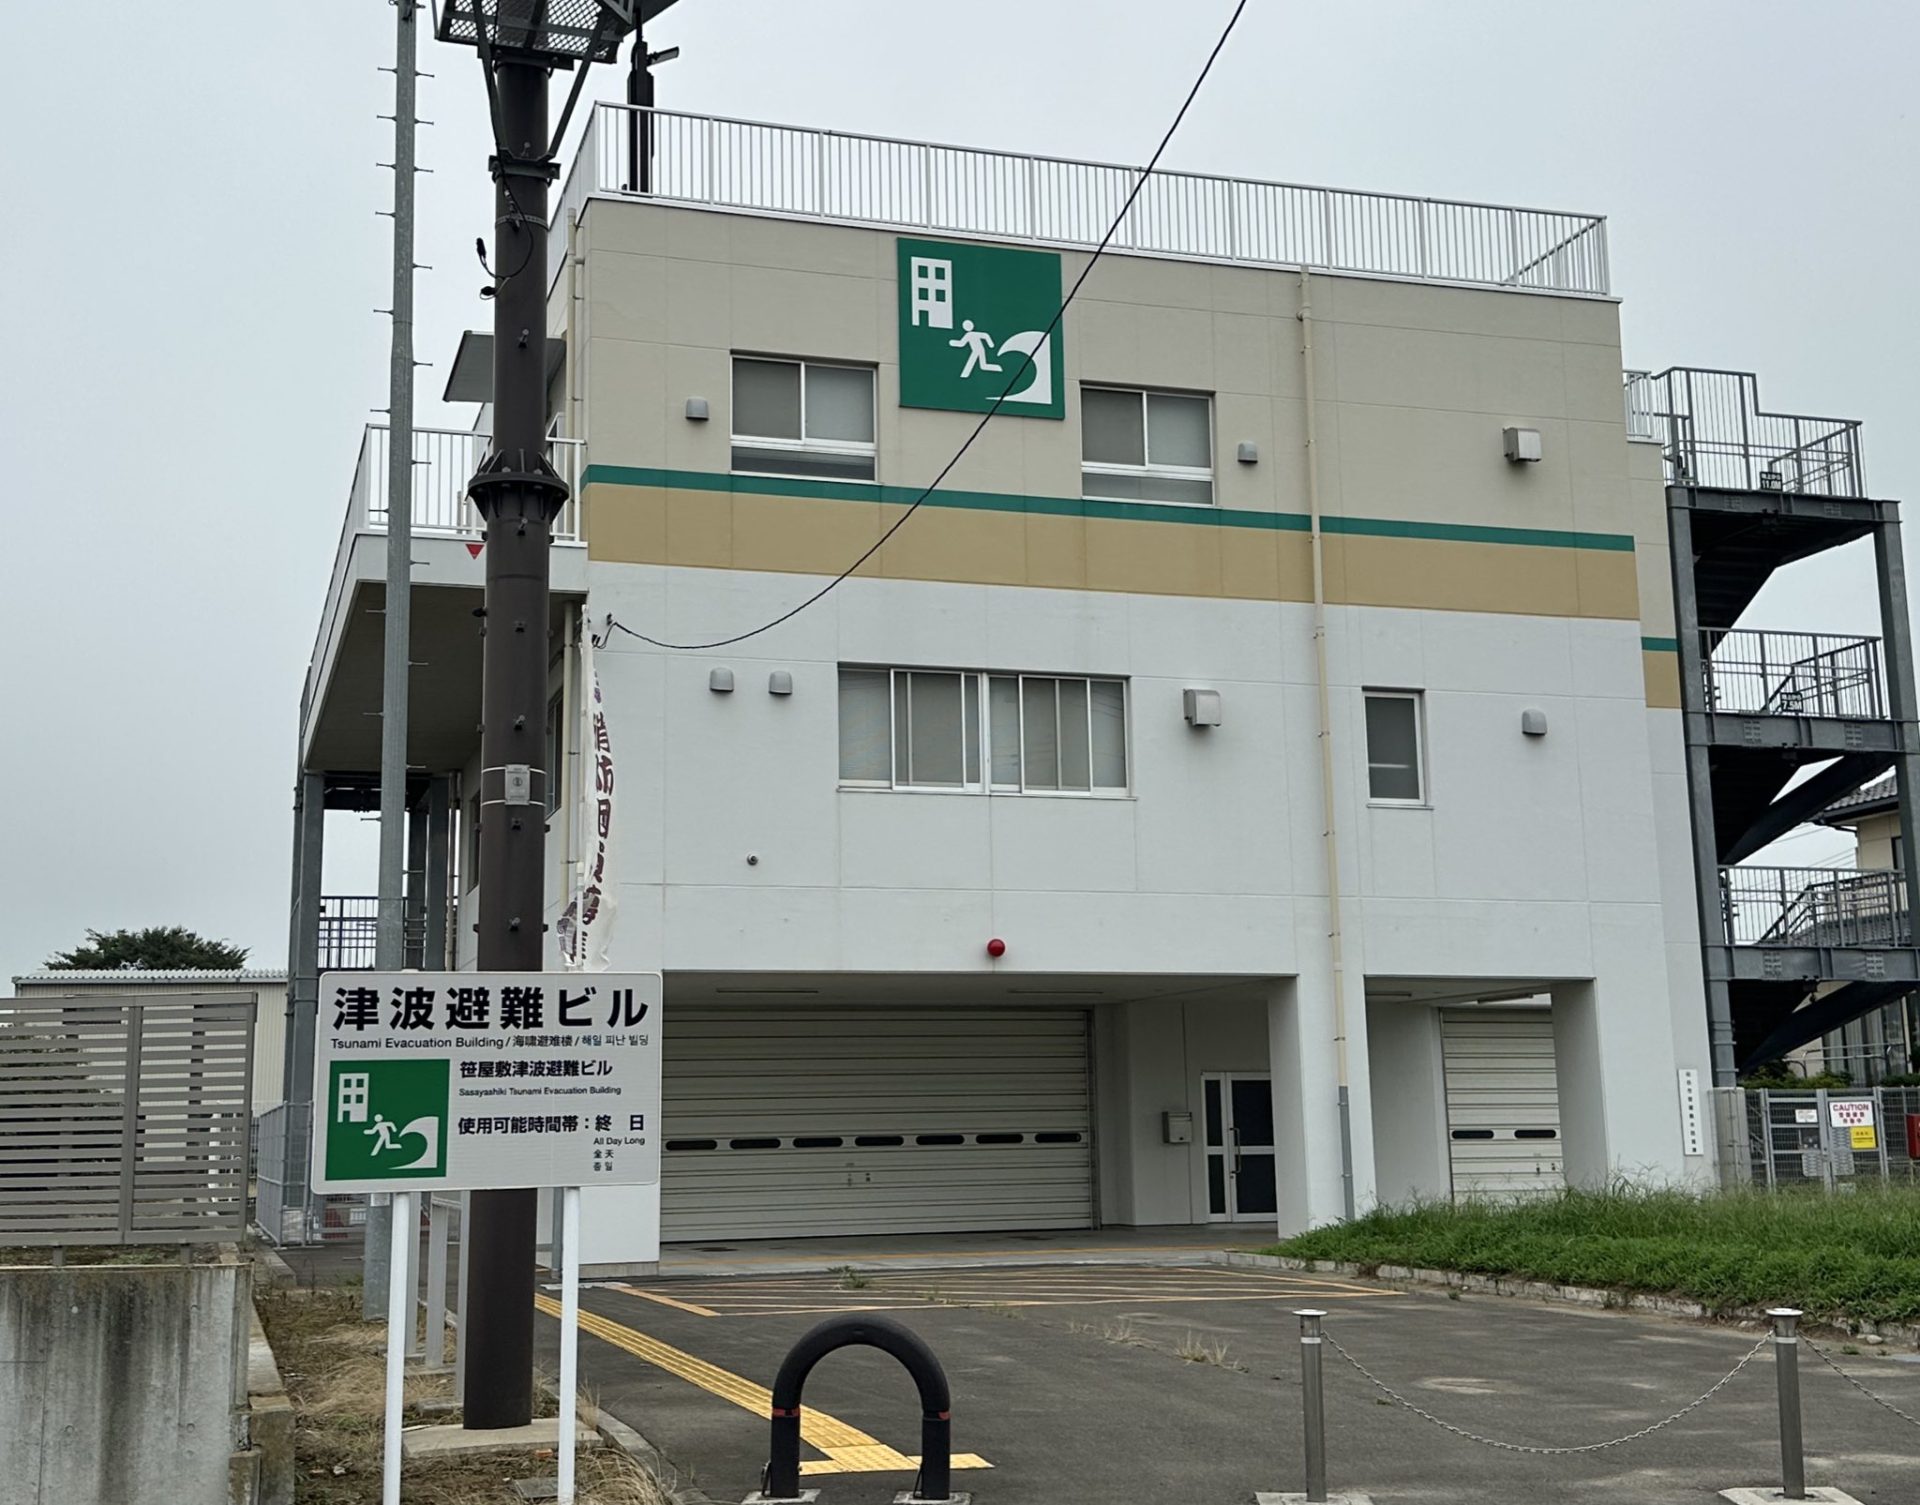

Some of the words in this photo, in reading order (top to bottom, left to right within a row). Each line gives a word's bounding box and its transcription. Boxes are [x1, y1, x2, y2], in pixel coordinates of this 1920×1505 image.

[333, 986, 649, 1031] 津波避難ビル
[331, 1038, 382, 1049] Tsunami
[385, 1037, 451, 1048] Evacuation
[455, 1037, 504, 1050] Building
[605, 1034, 626, 1046] 피난
[629, 1034, 649, 1046] 빌딩
[460, 1060, 613, 1078] 笹屋敷津波避難ビル
[459, 1087, 507, 1098] Sasayashiki
[509, 1087, 542, 1095] Tsunami
[543, 1087, 588, 1095] Evacuation
[589, 1086, 622, 1096] Building
[593, 1137, 604, 1145] All
[606, 1137, 622, 1146] Day
[624, 1136, 645, 1146] Long
